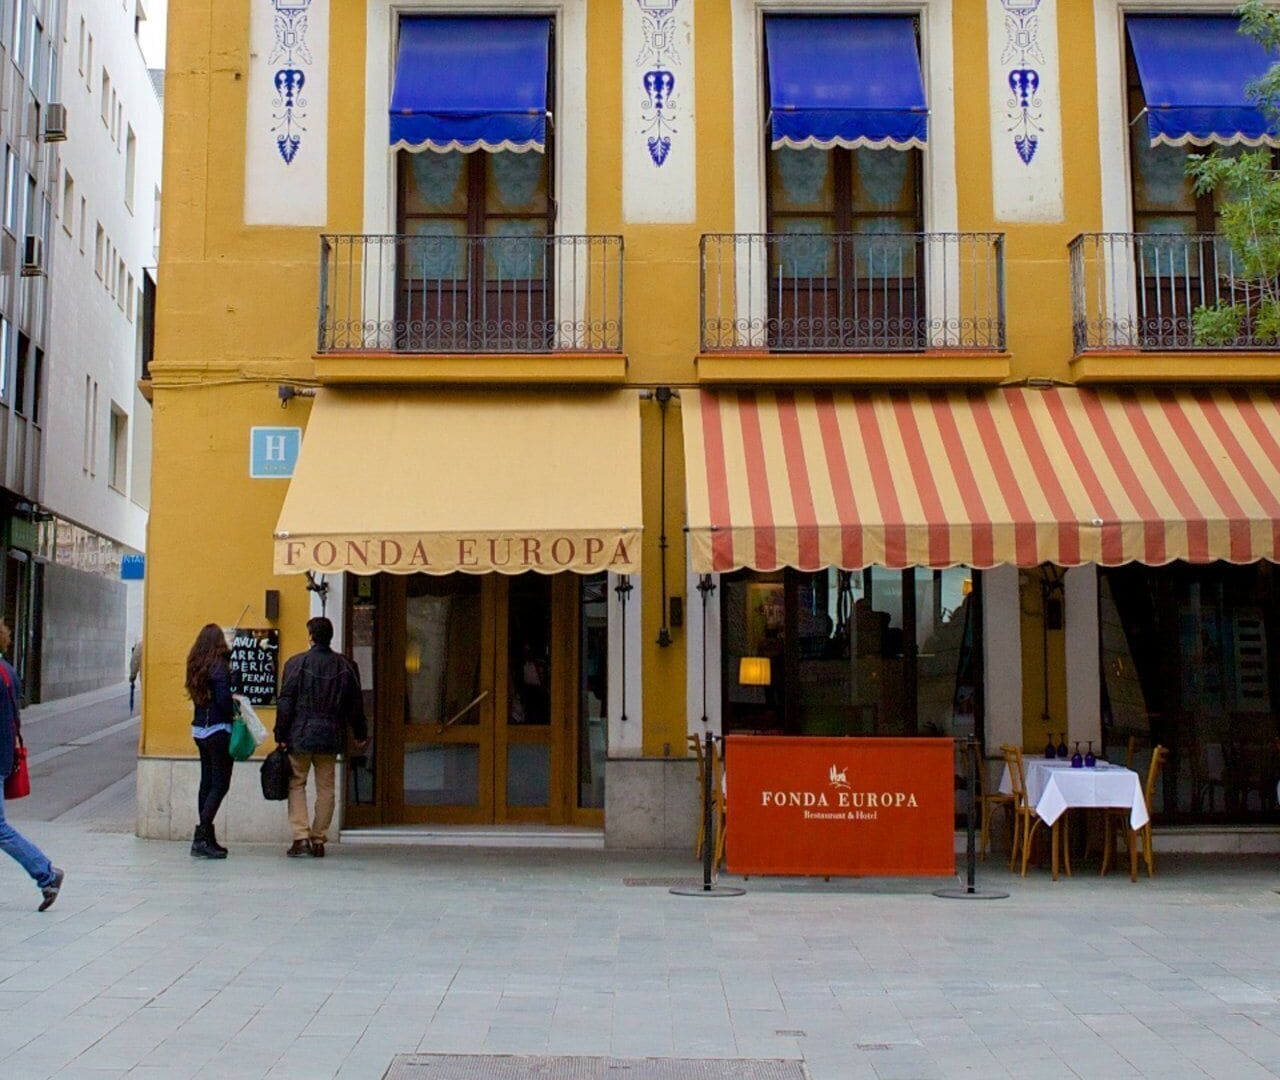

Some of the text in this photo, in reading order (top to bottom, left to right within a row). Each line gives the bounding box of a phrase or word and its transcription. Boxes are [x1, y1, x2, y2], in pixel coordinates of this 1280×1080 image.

[266, 435, 287, 462] H
[283, 536, 634, 567] FONDA EUROPA
[233, 636, 257, 649] AVUI
[761, 791, 920, 808] FONDA EUROPA
[803, 809, 878, 820] Restaurant & Hotel
